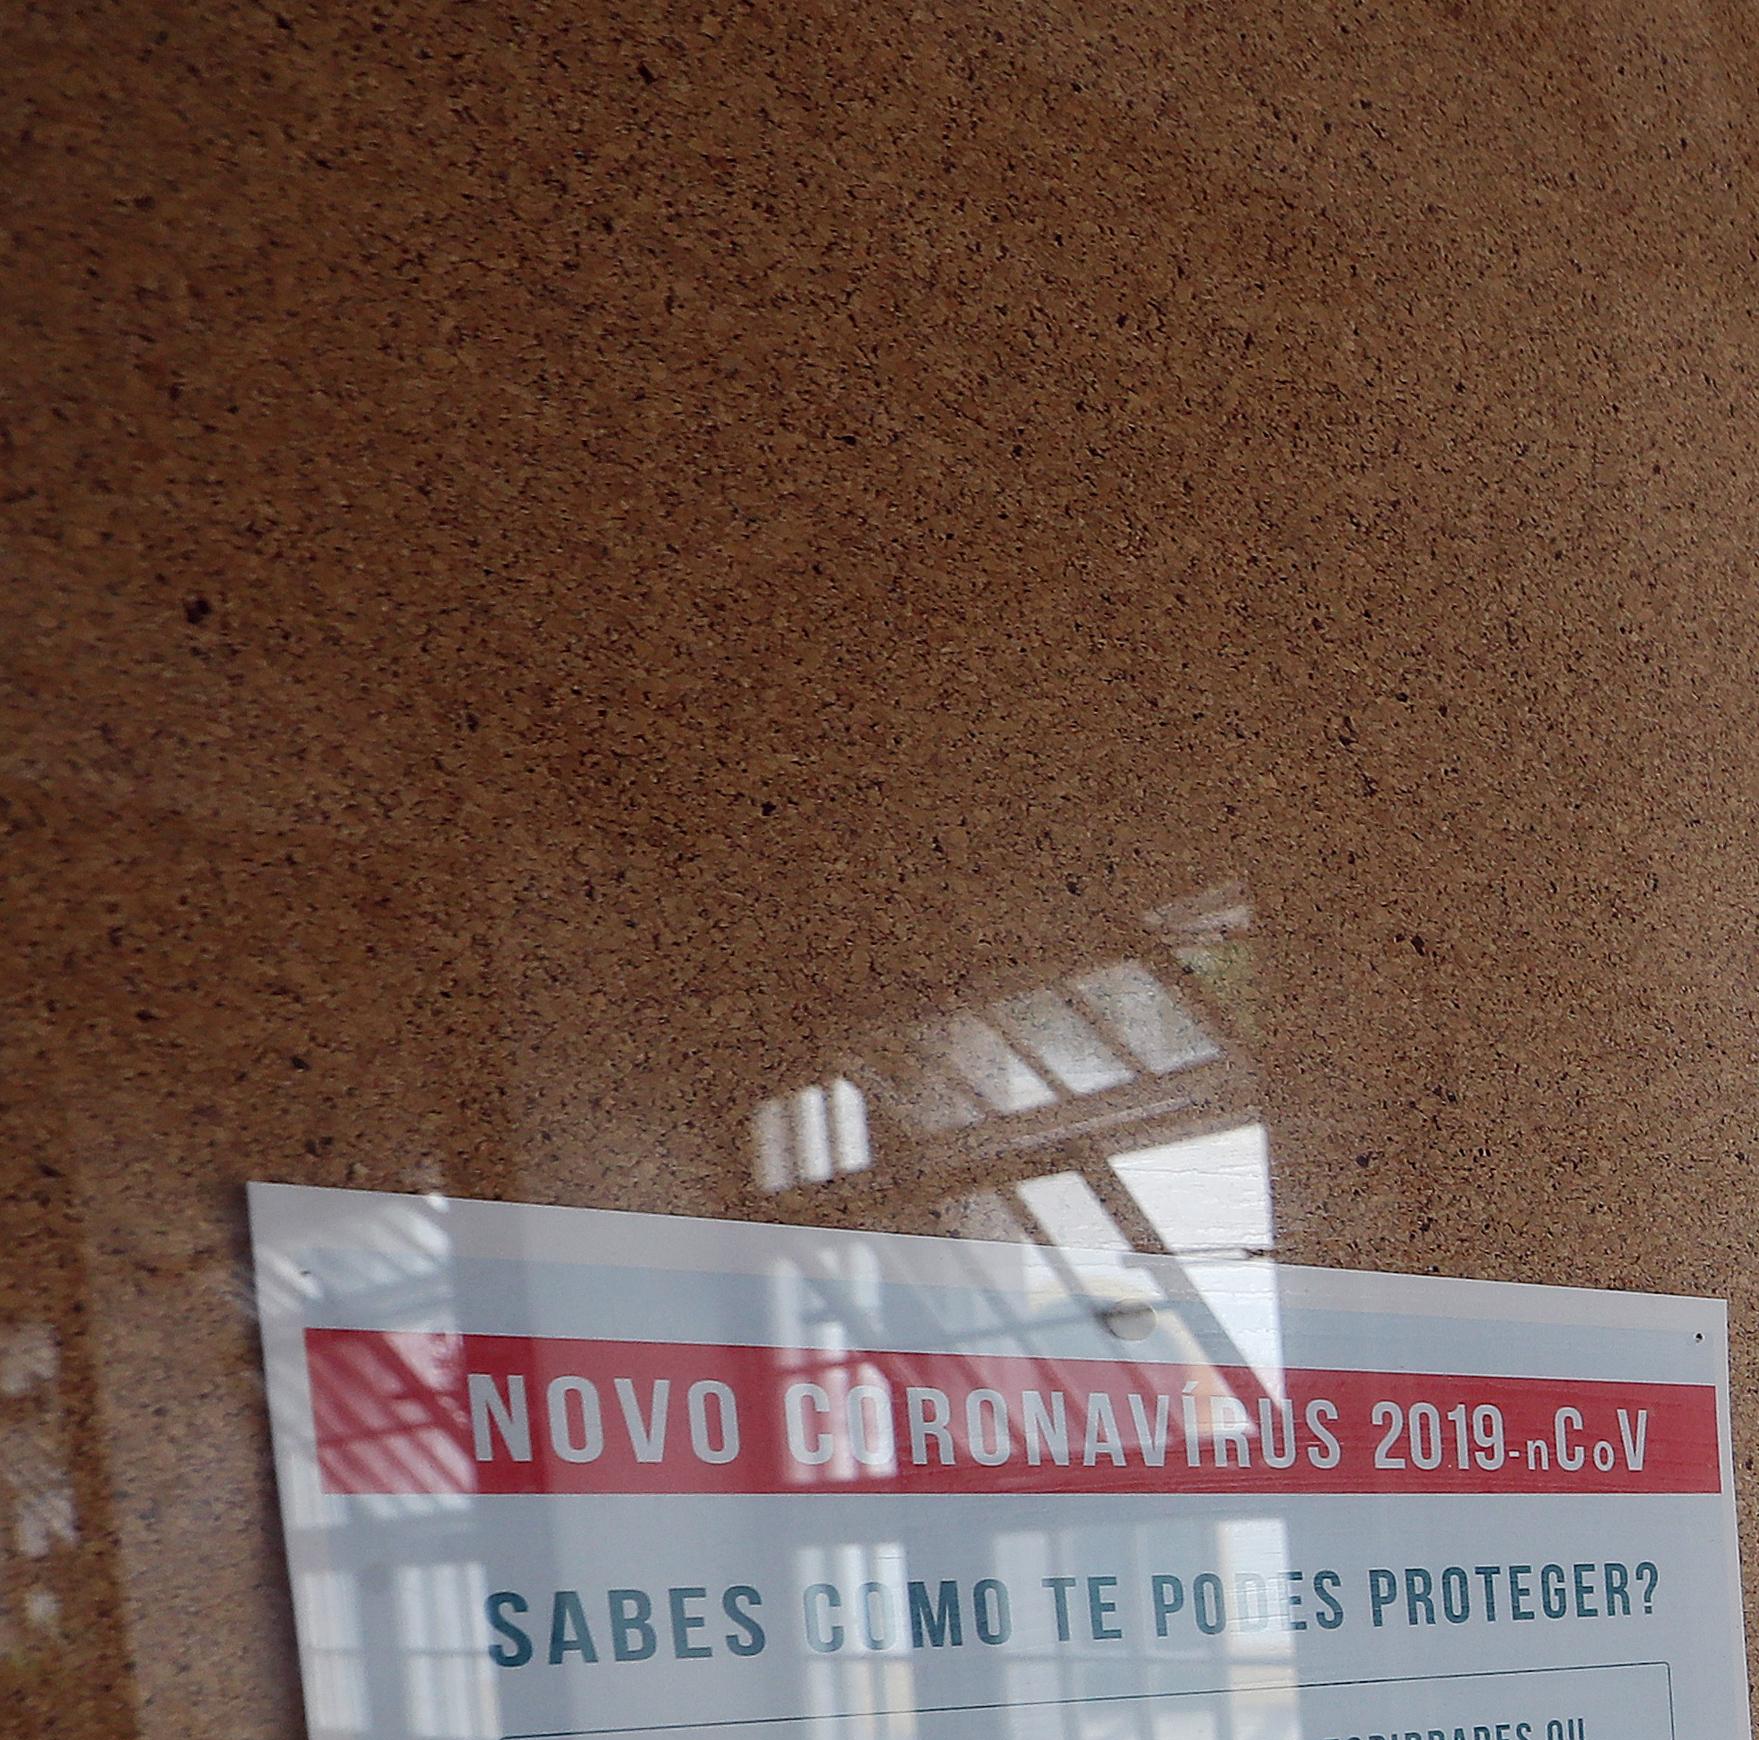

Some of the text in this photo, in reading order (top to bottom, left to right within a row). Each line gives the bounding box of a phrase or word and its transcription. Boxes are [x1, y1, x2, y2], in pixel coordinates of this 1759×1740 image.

[466, 1372, 1649, 1472] NOVO CORONAVÍRUS 2019-nCoV
[485, 1561, 1660, 1668] SABES COMO TE PODES PROTEGER?
